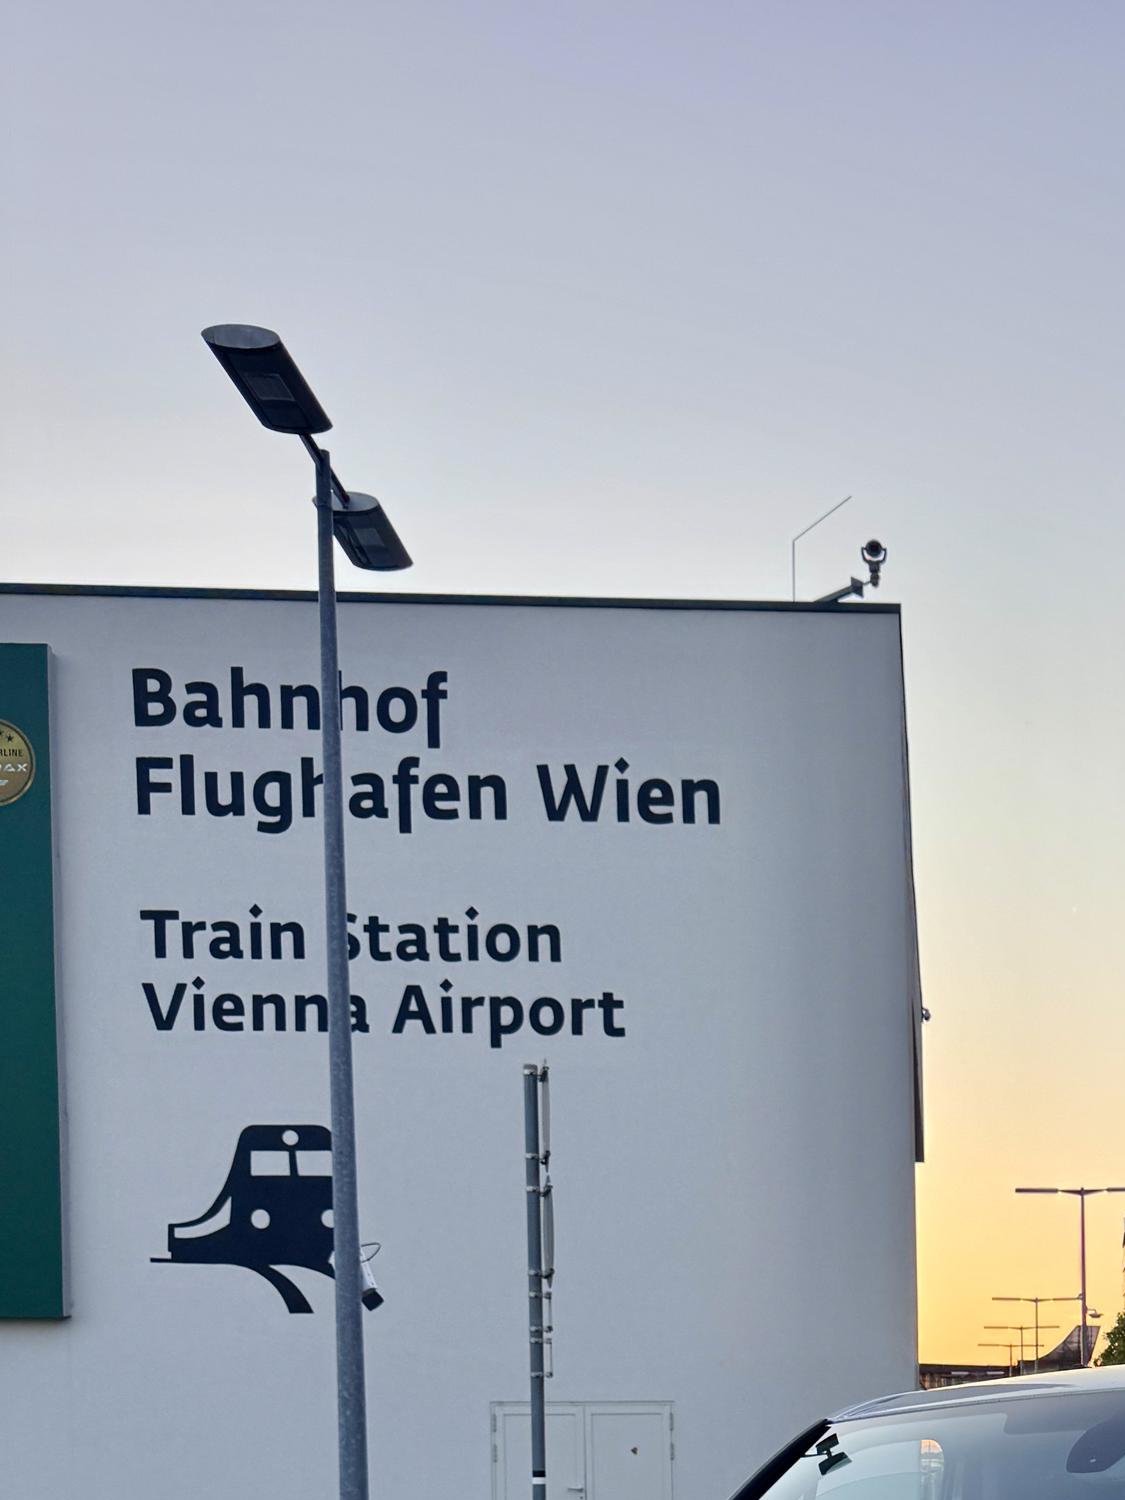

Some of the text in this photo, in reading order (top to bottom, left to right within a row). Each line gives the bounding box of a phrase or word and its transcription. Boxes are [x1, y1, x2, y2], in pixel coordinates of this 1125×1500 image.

[132, 667, 448, 749] Bahnhof
[136, 754, 721, 834] Flughafen Wien
[140, 904, 305, 960] Train
[142, 977, 626, 1049] Vienna Airport
